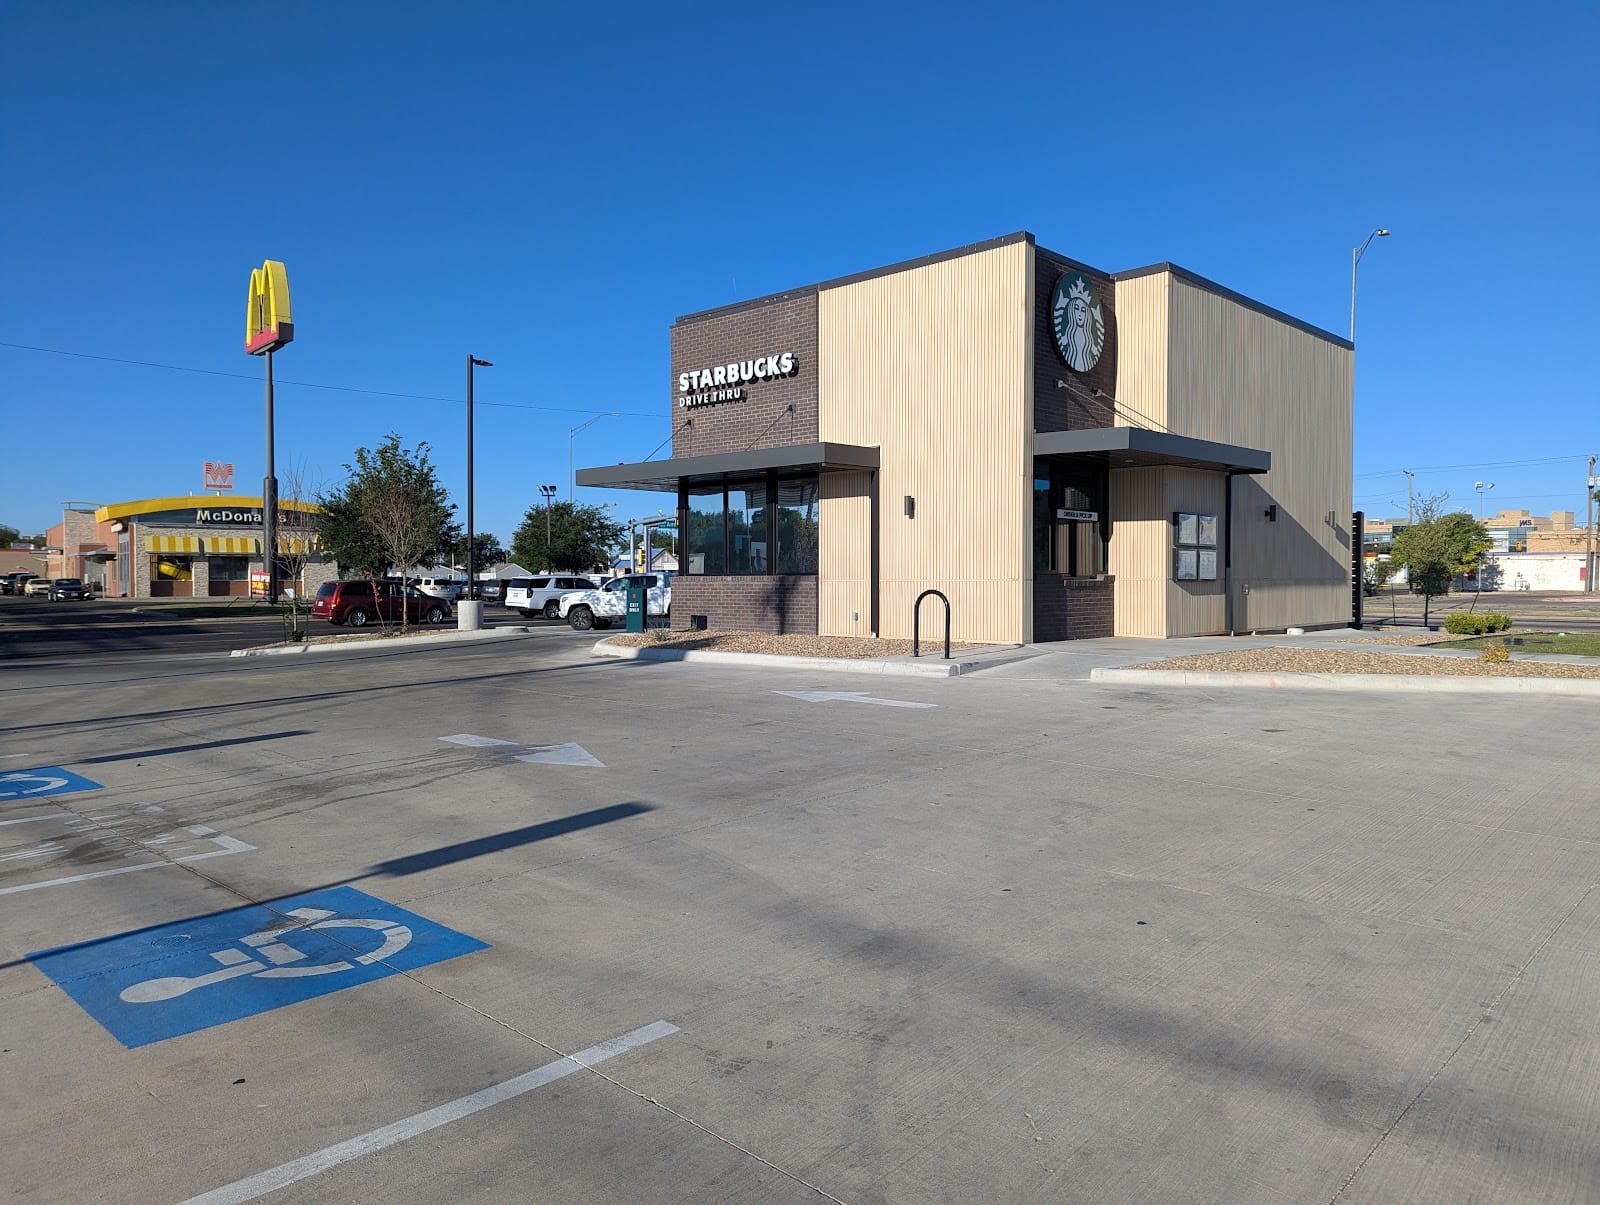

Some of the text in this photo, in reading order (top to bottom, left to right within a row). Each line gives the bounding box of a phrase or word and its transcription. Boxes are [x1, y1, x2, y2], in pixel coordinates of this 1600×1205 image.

[679, 353, 793, 391] STARBUCKS
[679, 388, 741, 407] DRIVE THRU
[196, 510, 287, 523] McDona's
